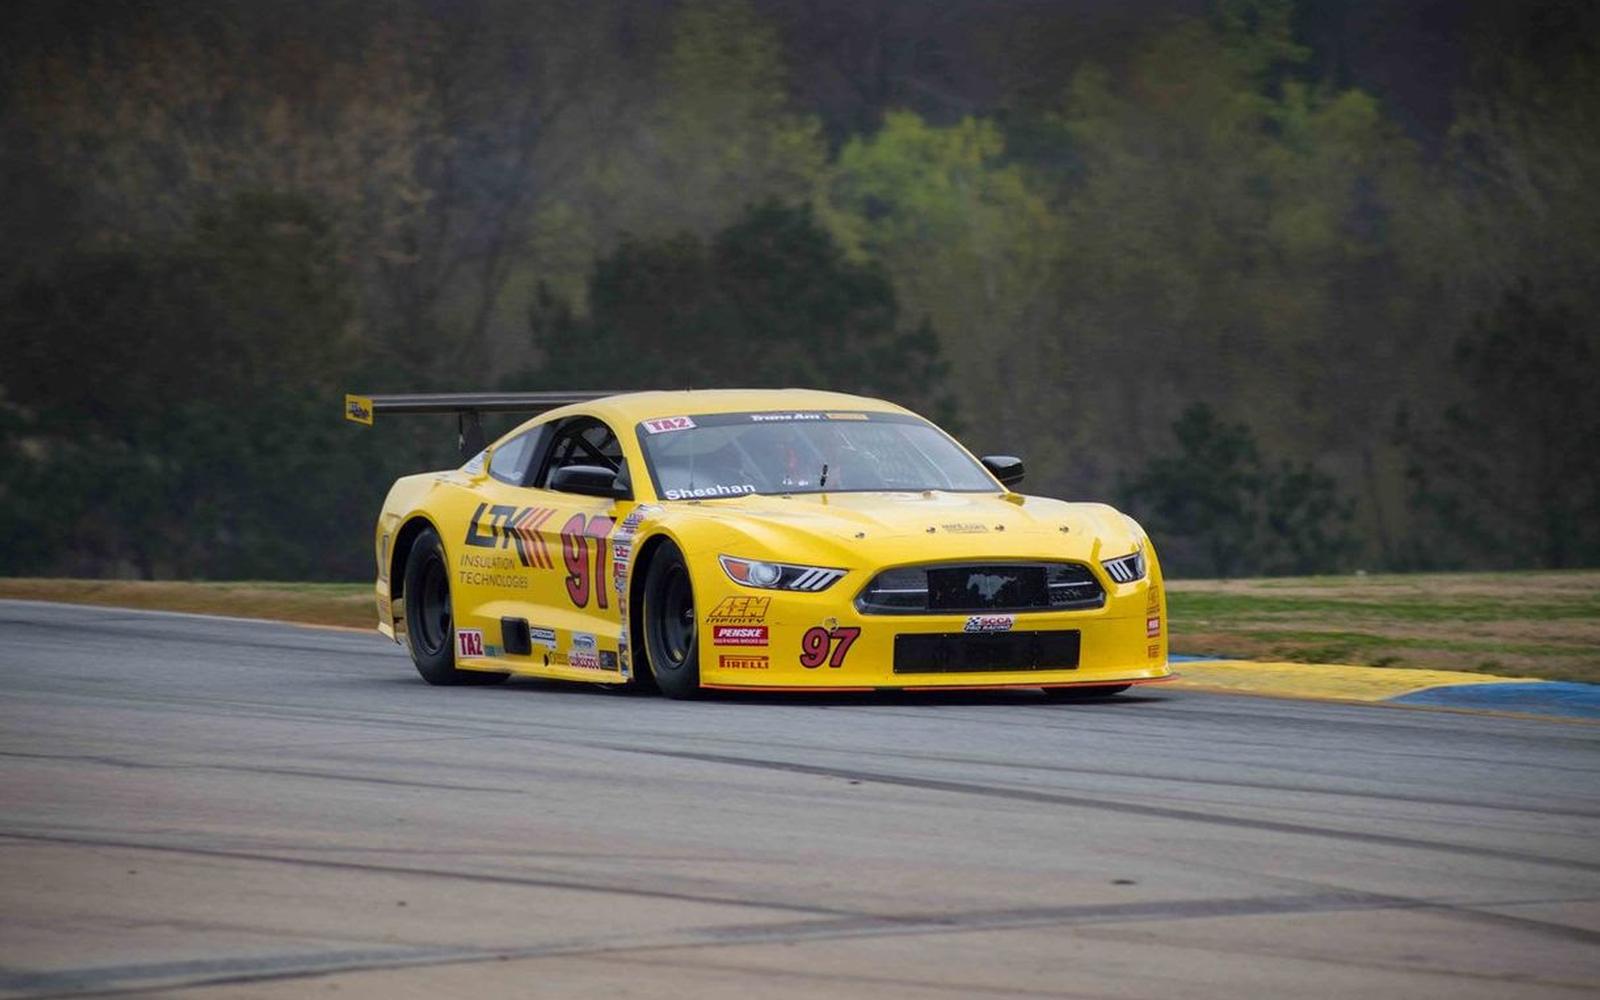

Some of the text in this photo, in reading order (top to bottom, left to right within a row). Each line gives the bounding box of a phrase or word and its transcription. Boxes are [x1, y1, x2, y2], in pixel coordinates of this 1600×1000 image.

[650, 418, 690, 432] TA2
[665, 484, 757, 500] Sheehan
[464, 502, 530, 567] LTK
[459, 554, 515, 570] INSULATION
[560, 512, 617, 609] 97
[458, 571, 528, 589] TECHNOLOGIES
[709, 596, 771, 618] AEM
[981, 616, 1012, 626] SCCA
[718, 628, 763, 638] PENSKE
[458, 632, 483, 656] TA2
[800, 626, 862, 669] 97
[719, 655, 769, 669] PIRELLI
